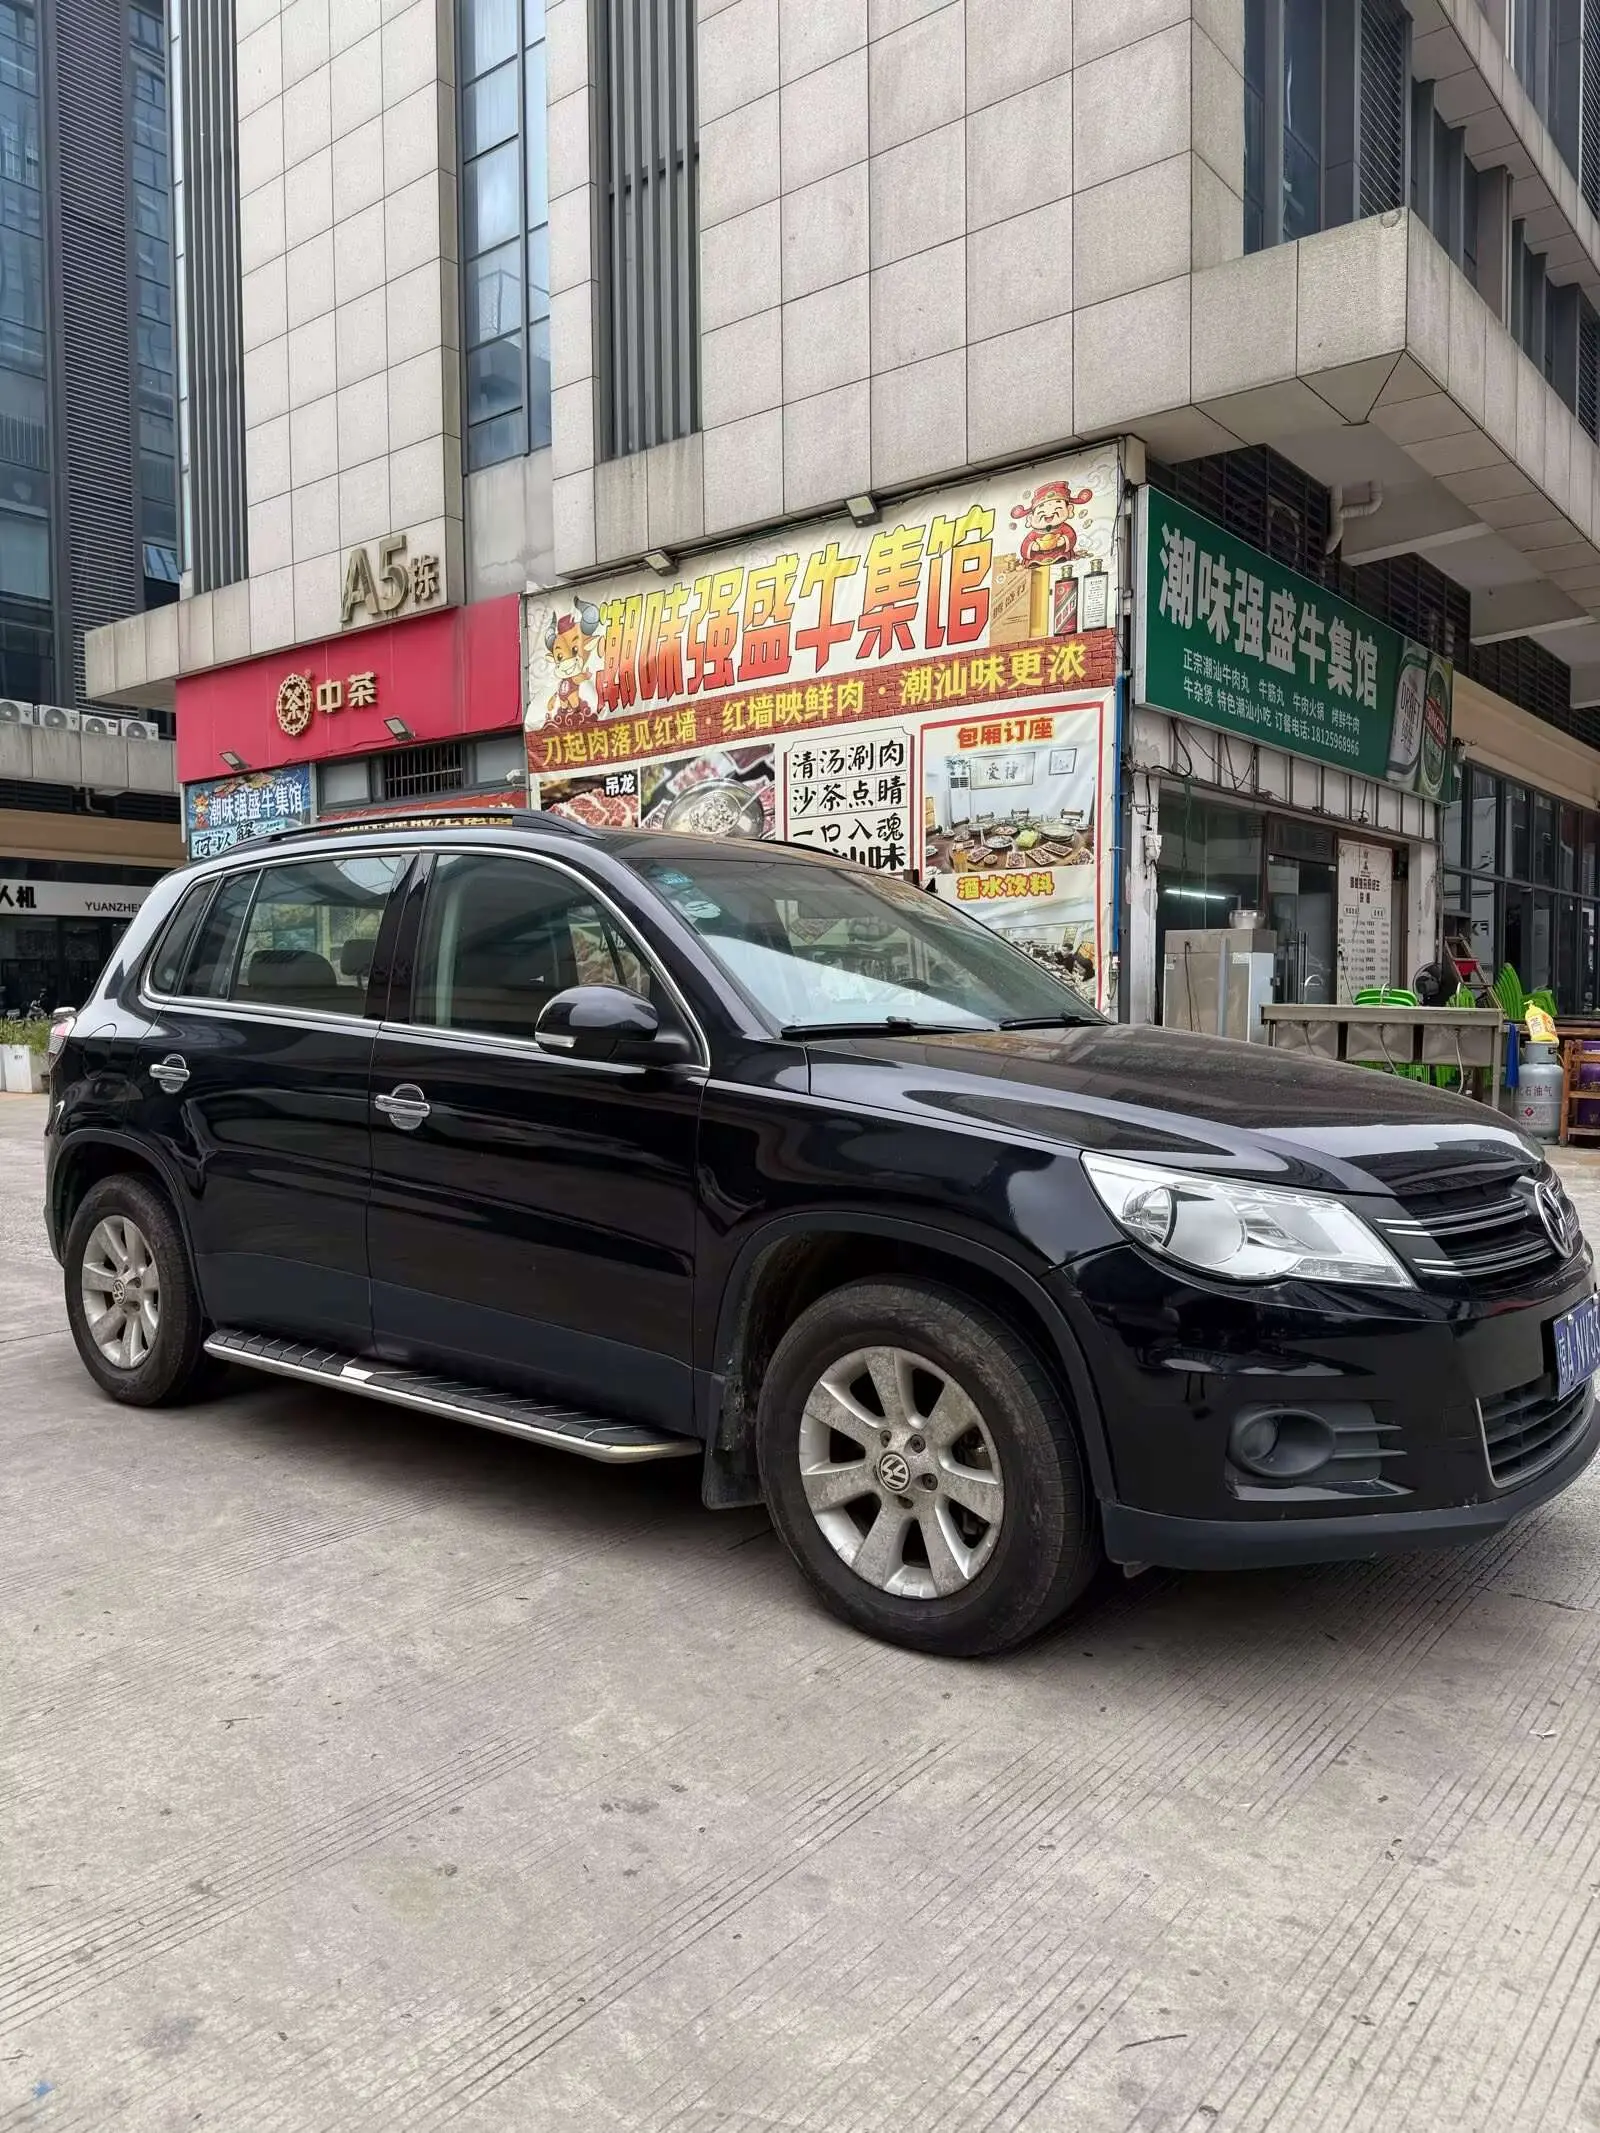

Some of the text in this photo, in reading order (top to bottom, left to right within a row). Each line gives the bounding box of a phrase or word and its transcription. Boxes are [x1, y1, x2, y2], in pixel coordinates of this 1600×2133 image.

[341, 535, 440, 623] A5栋
[595, 505, 995, 714] 潮味强盛牛集馆
[1159, 522, 1378, 710] 潮味强盛牛集馆
[1183, 647, 1250, 694] 正宗潮汕牛肉丸
[316, 671, 377, 713] 中茶
[957, 717, 1054, 749] 包厢订座
[792, 740, 905, 779] 清汤涮肉
[605, 772, 636, 797] 吊龙
[793, 775, 906, 816] 沙茶点睛
[209, 784, 304, 828] 潮味强盛牛集馆
[792, 812, 904, 843] 一口入魂
[956, 871, 1055, 900] 酒水饮料
